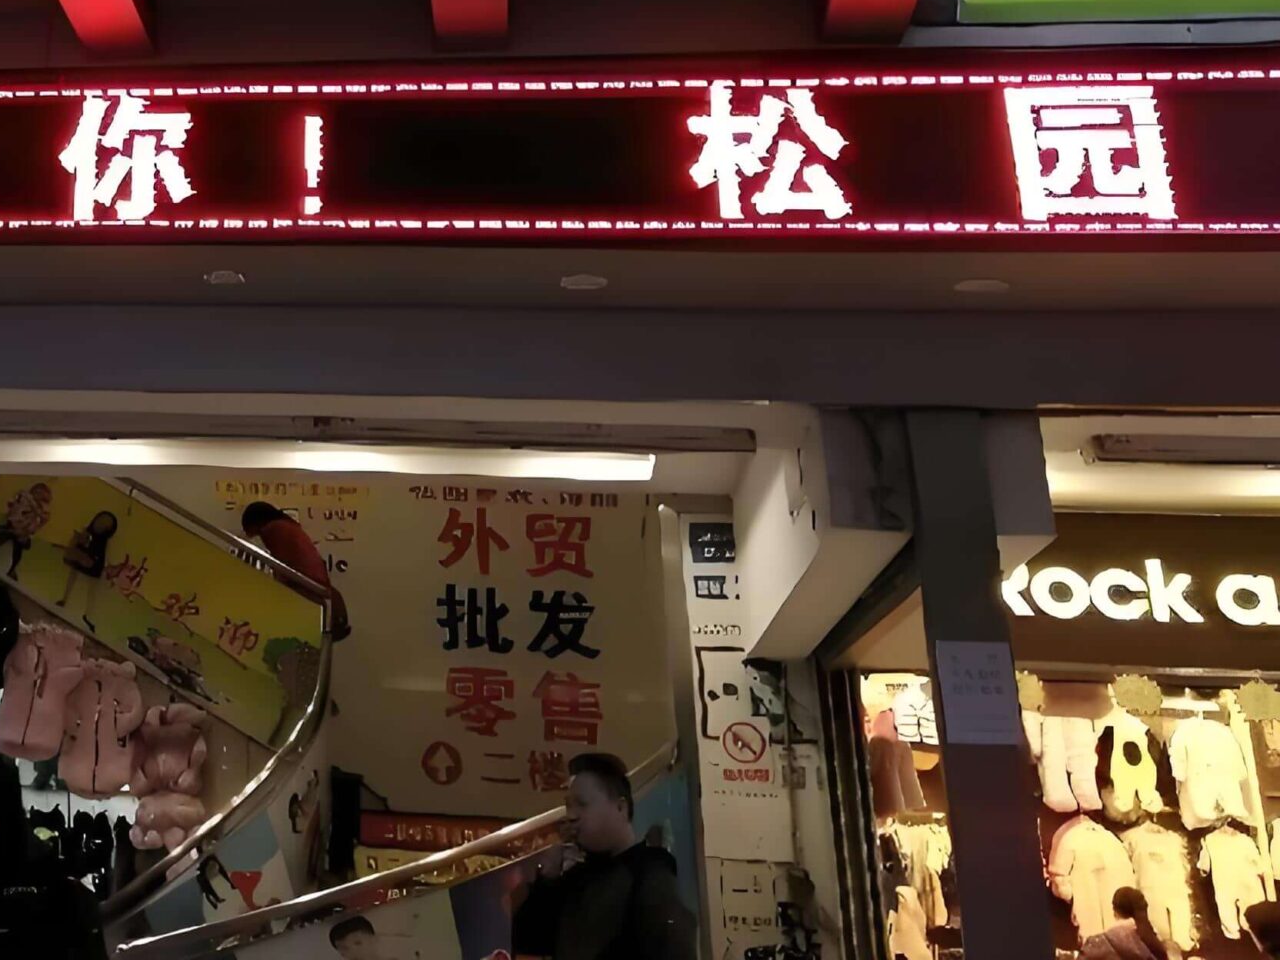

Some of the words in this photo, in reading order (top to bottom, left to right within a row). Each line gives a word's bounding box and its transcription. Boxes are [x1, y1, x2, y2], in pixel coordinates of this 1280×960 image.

[687, 81, 1179, 222] 松园
[436, 507, 595, 578] 外贸
[436, 583, 601, 659] 批发
[444, 666, 604, 745] 零售
